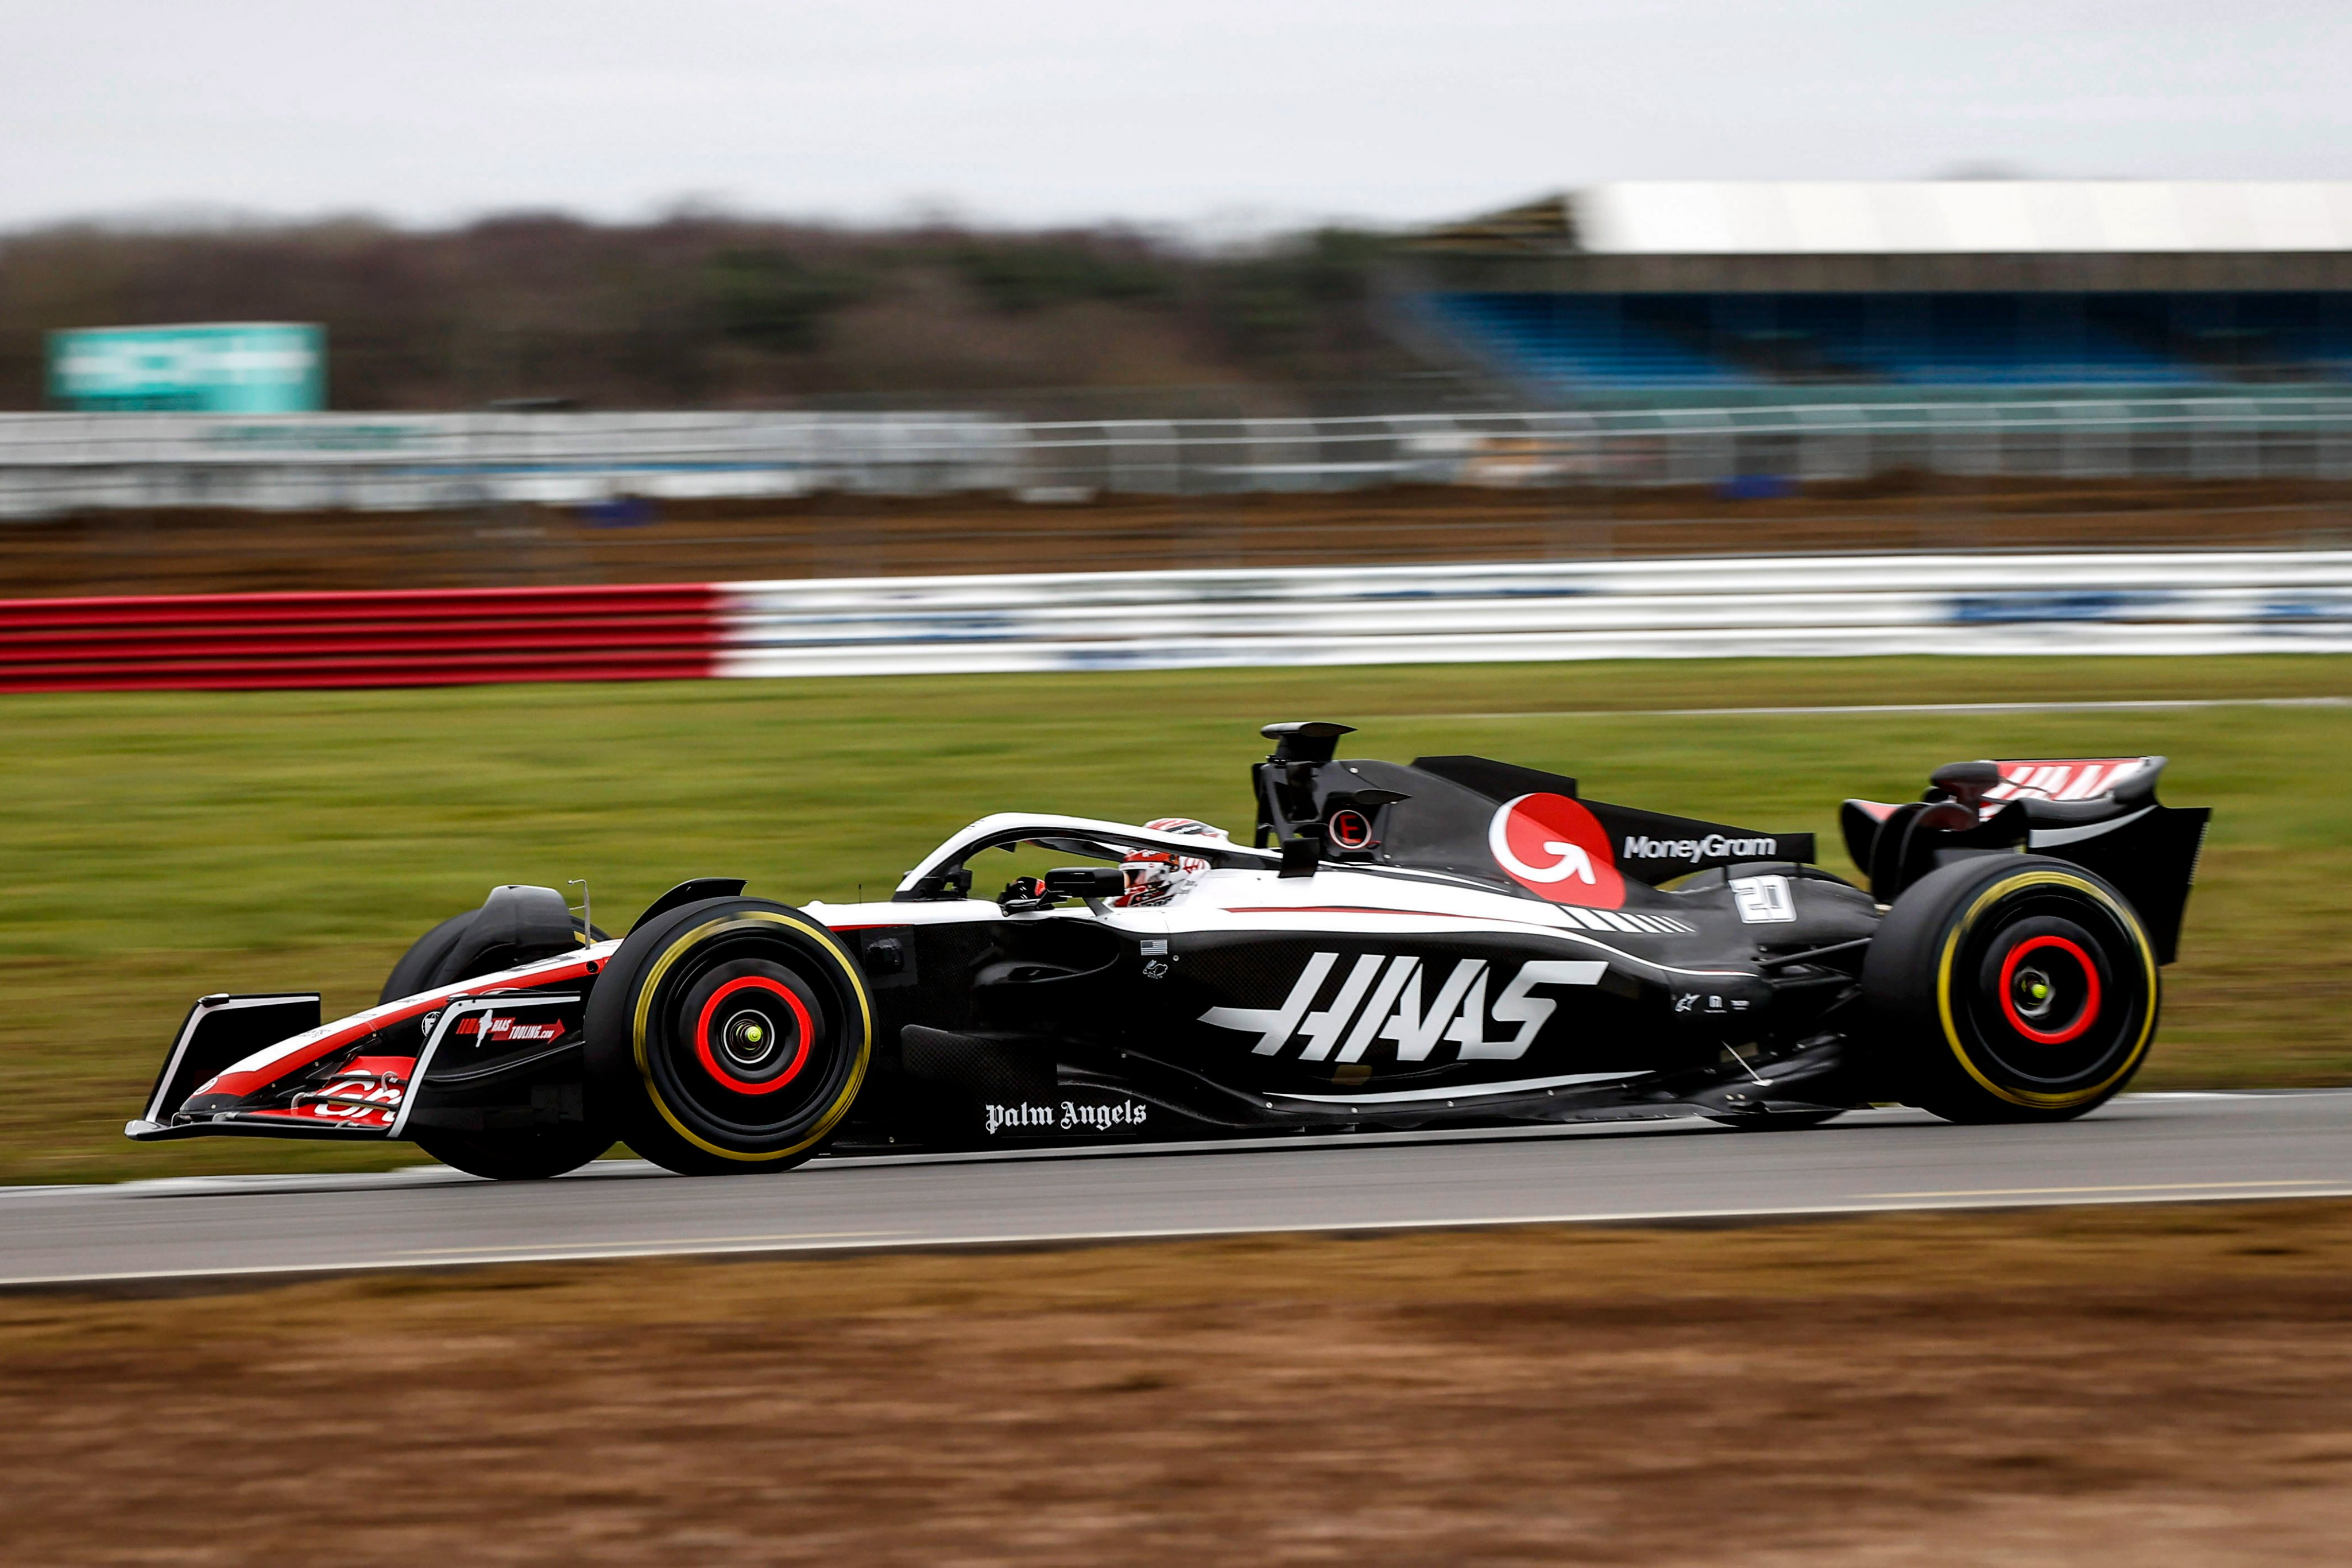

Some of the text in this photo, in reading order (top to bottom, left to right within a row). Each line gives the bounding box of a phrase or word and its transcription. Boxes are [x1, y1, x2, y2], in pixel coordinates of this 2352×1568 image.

[1623, 834, 1777, 863] MoneyGram
[1728, 875, 1797, 924] 20
[491, 1019, 513, 1032] HAAS
[1197, 952, 1610, 1063] HAAS
[985, 1099, 1147, 1135] Palm Angels
